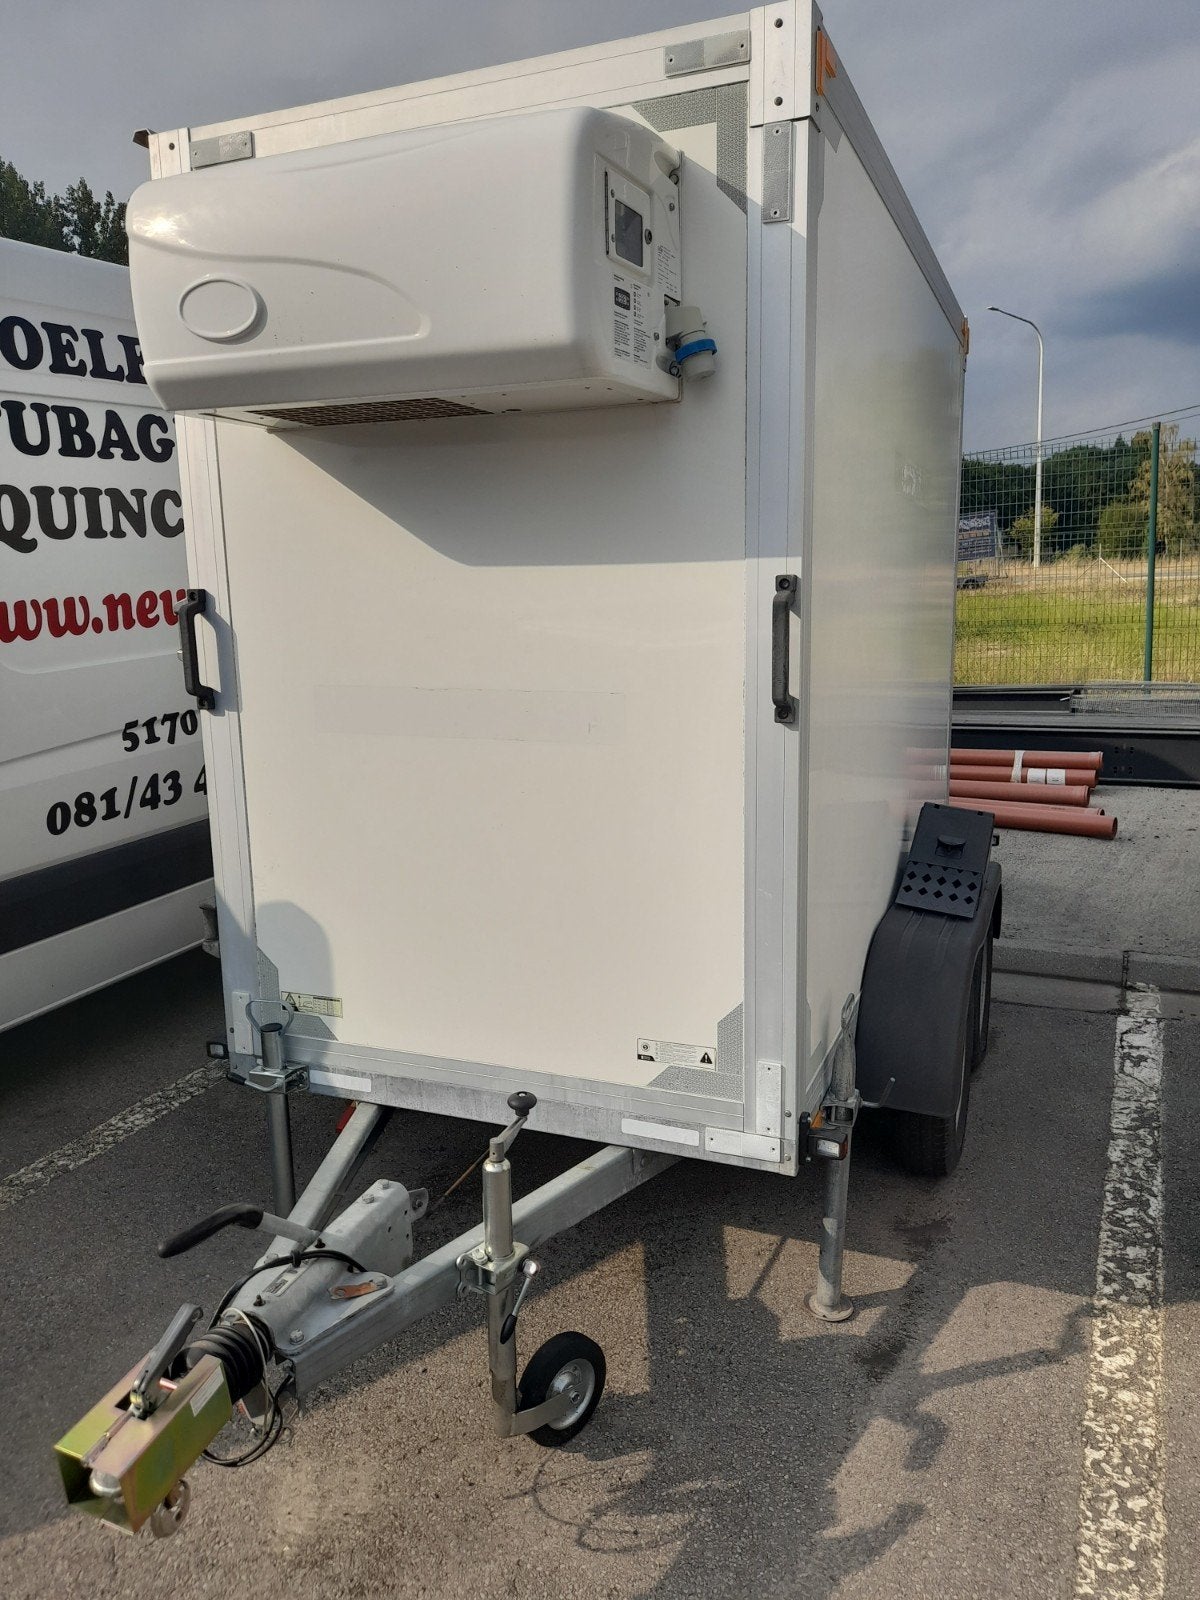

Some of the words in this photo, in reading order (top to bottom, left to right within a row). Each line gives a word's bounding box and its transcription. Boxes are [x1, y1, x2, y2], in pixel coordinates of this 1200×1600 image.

[0, 400, 175, 463] UBAG
[0, 484, 185, 554] QUINC
[121, 709, 198, 752] 5170
[46, 770, 183, 836] 081/43
